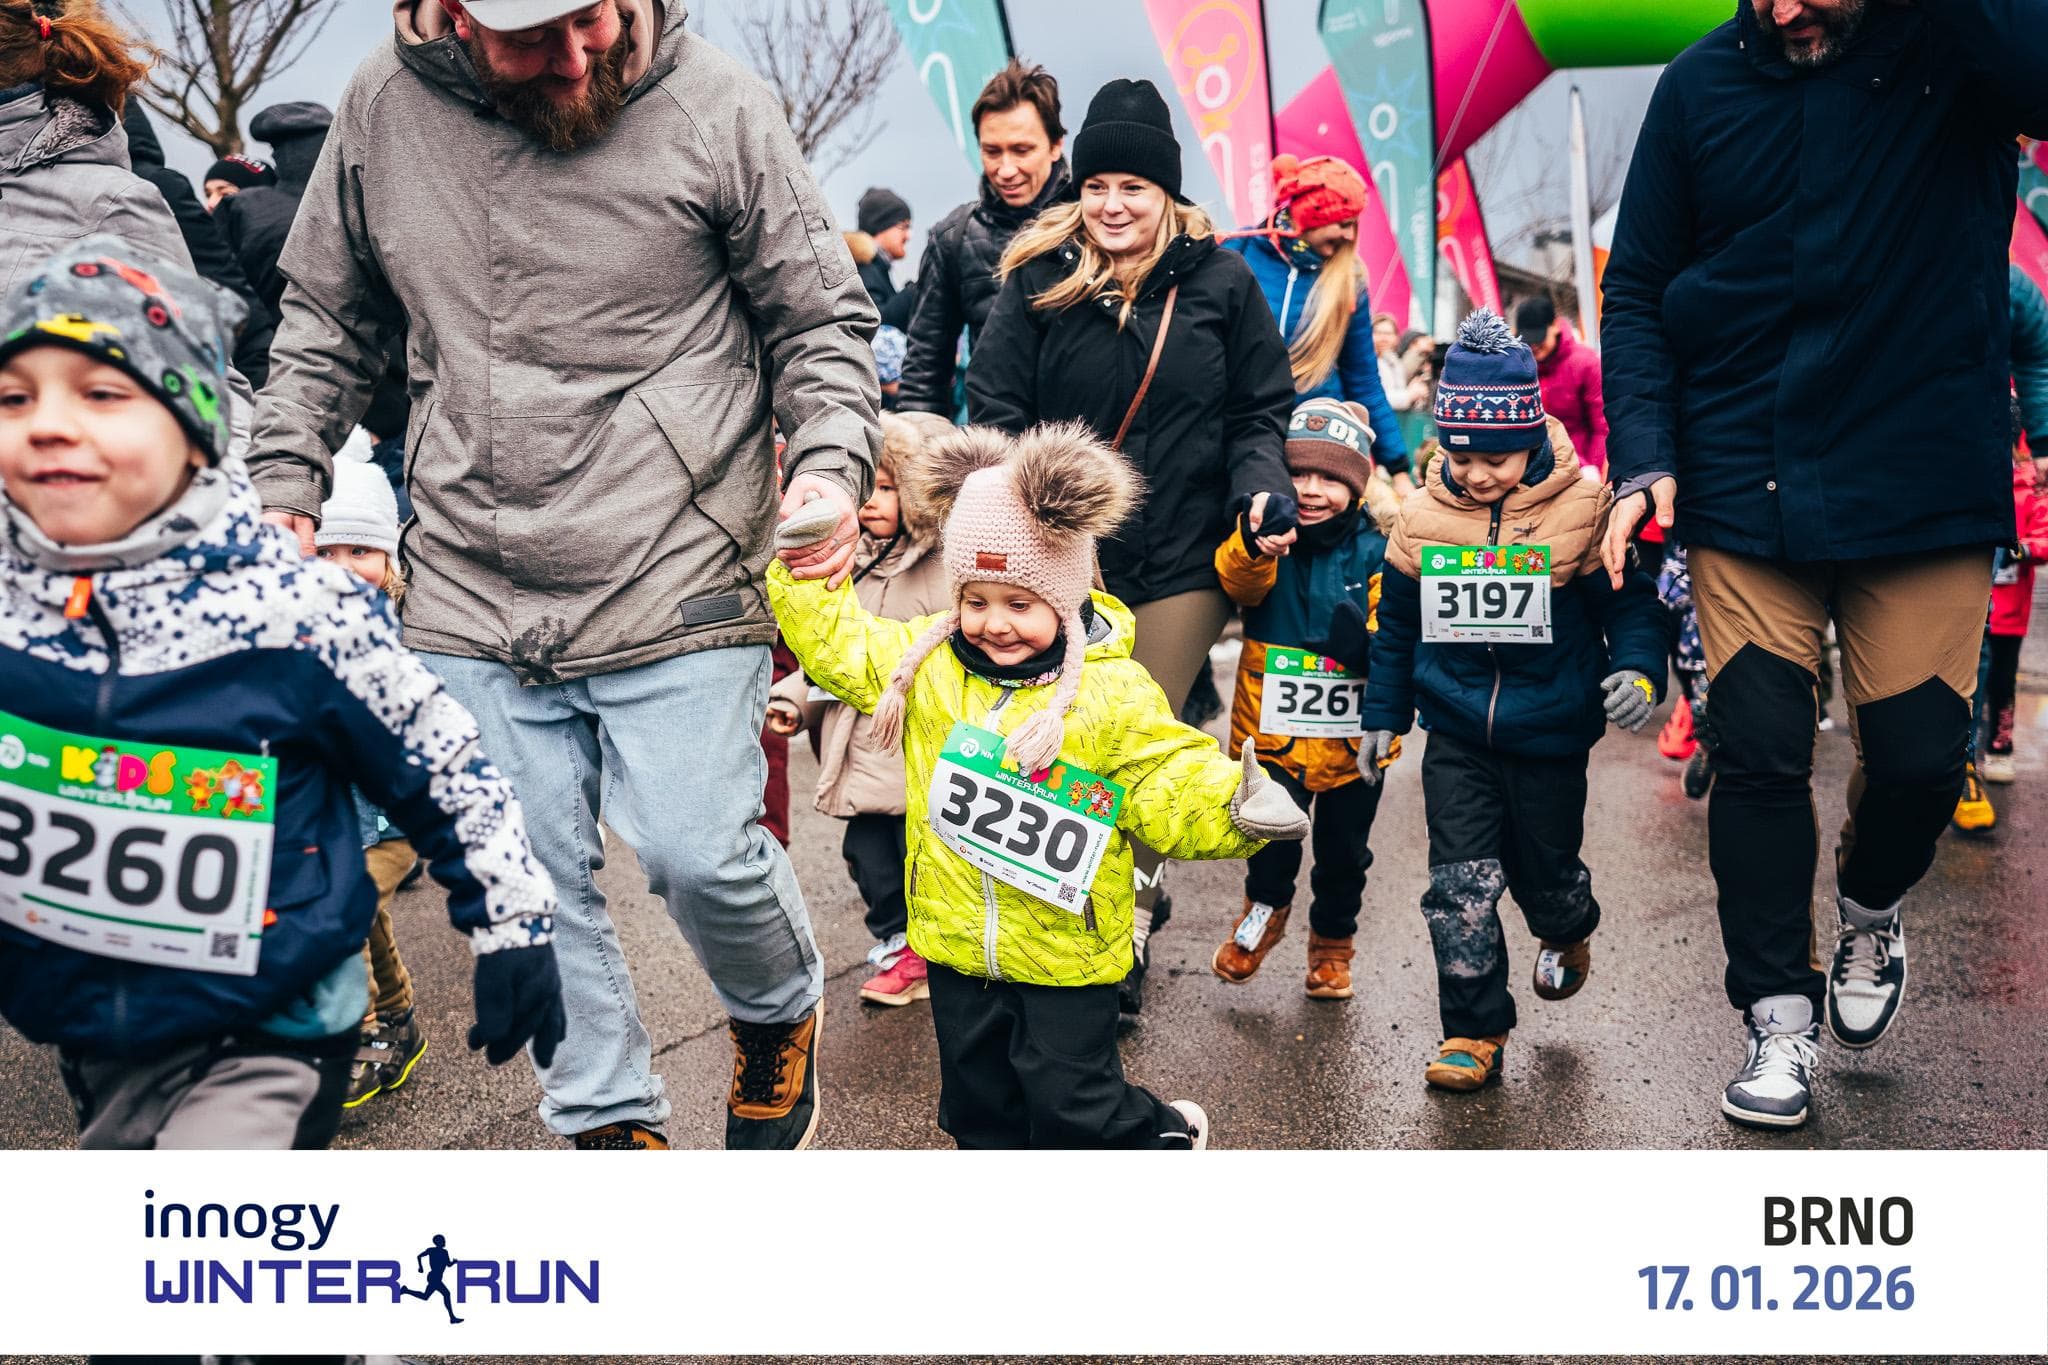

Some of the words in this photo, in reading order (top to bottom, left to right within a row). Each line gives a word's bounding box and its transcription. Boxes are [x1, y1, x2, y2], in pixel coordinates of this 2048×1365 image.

[1437, 581, 1534, 619] 3197
[1277, 681, 1364, 716] 3261
[995, 770, 1032, 791] WINTER
[1036, 786, 1058, 801] RUN
[941, 772, 1089, 873] 3230
[0, 797, 239, 915] 3260
